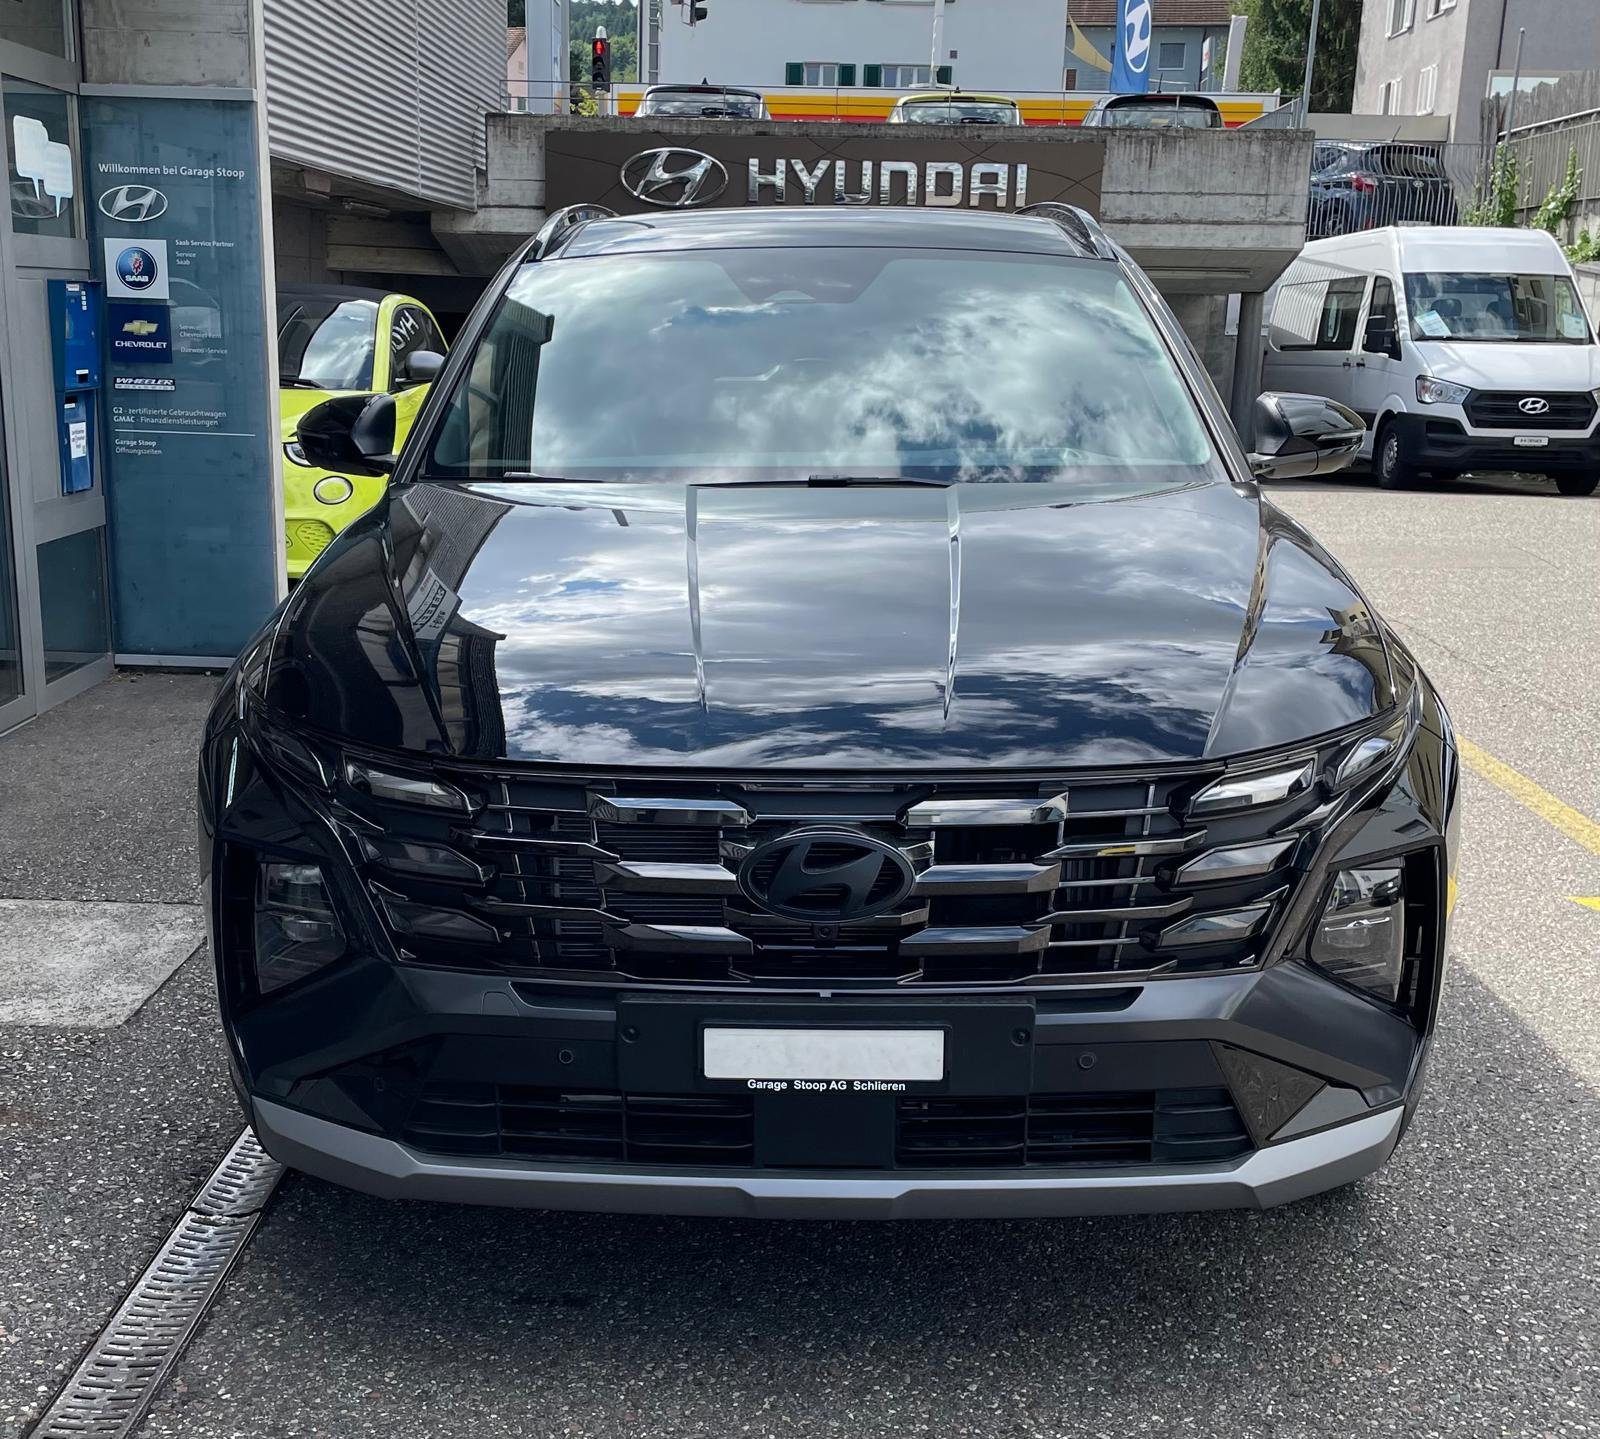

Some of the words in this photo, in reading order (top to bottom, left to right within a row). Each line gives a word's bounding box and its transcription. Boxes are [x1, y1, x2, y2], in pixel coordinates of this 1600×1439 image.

[98, 163, 161, 175] Willkommen
[162, 166, 178, 175] bei
[179, 166, 215, 179] Garage
[216, 169, 245, 180] Stoop
[748, 158, 1028, 207] HYUNDAI
[115, 340, 167, 349] CHEVROLET
[116, 377, 174, 385] WHEELER
[128, 408, 168, 416] zertifizierte
[168, 409, 227, 419] Gebrauchtwagen
[140, 417, 219, 427] Finanzdienstleistungen
[747, 1079, 788, 1092] Garage
[793, 1080, 827, 1092] Stoop
[829, 1080, 847, 1090] AG
[853, 1081, 906, 1091] Schlieren
